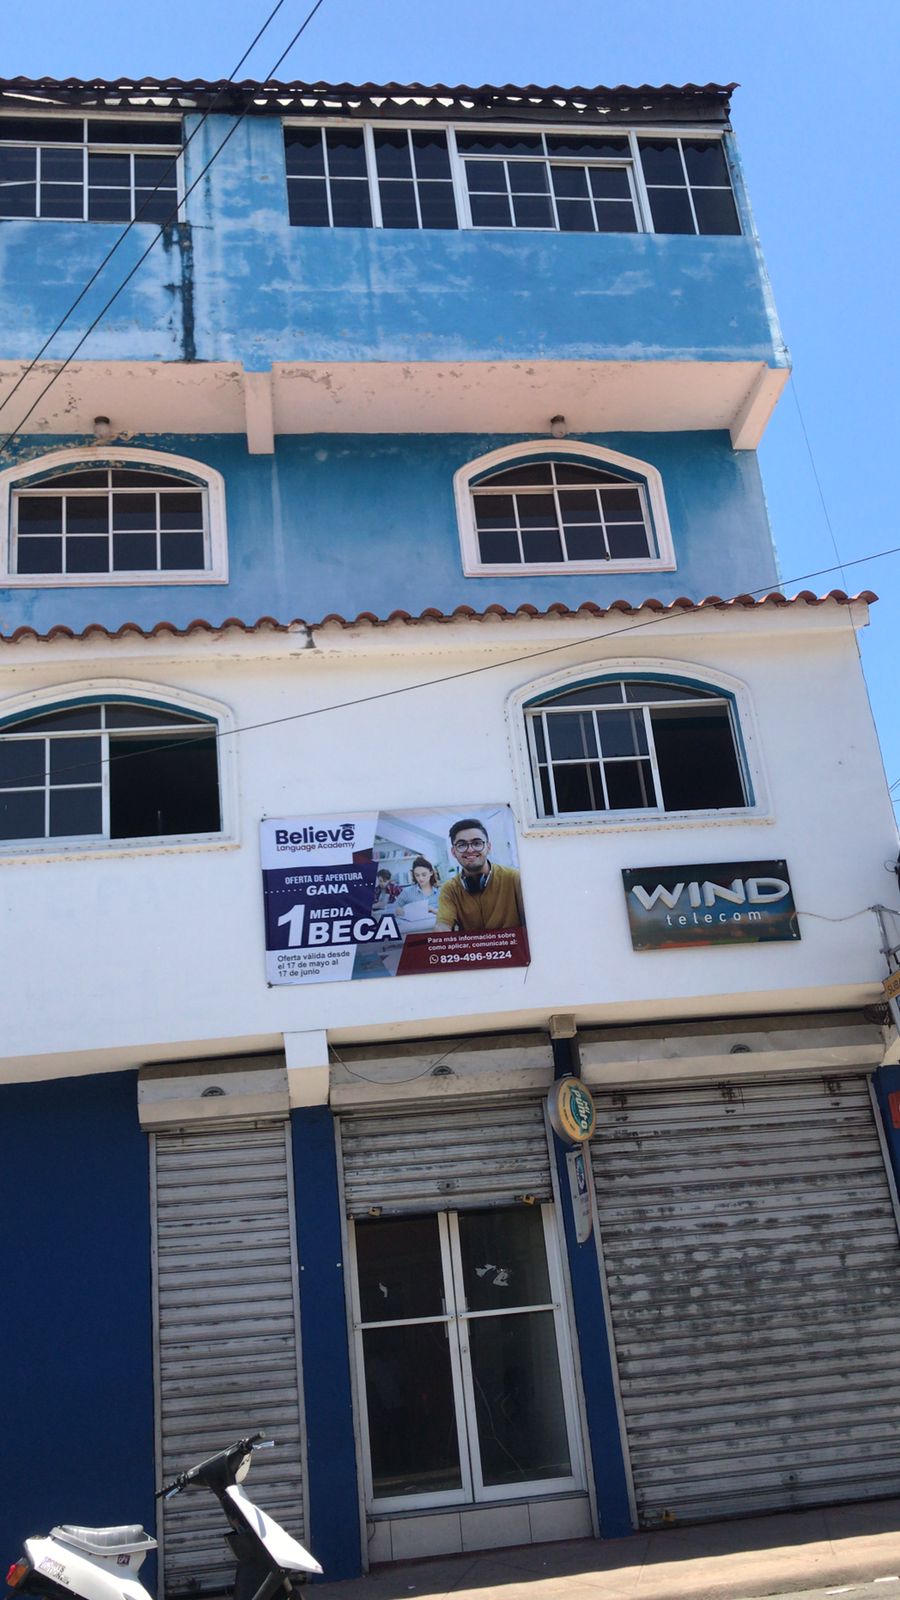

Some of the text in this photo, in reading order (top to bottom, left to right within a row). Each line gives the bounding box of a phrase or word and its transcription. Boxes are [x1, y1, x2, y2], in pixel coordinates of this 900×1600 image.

[275, 826, 354, 844] Believe
[276, 841, 355, 852] Language Academy
[285, 872, 363, 885] OFERTA DE APERTURA
[306, 884, 349, 895] GANA
[632, 877, 790, 911] WIND
[309, 907, 354, 919] MEDIA
[665, 910, 762, 926] telecom
[277, 904, 305, 947] 1
[308, 916, 399, 945] BECA
[327, 950, 350, 958] desde
[440, 950, 512, 963] 829-496-9224
[309, 960, 330, 968] mayo
[300, 968, 320, 977] junio
